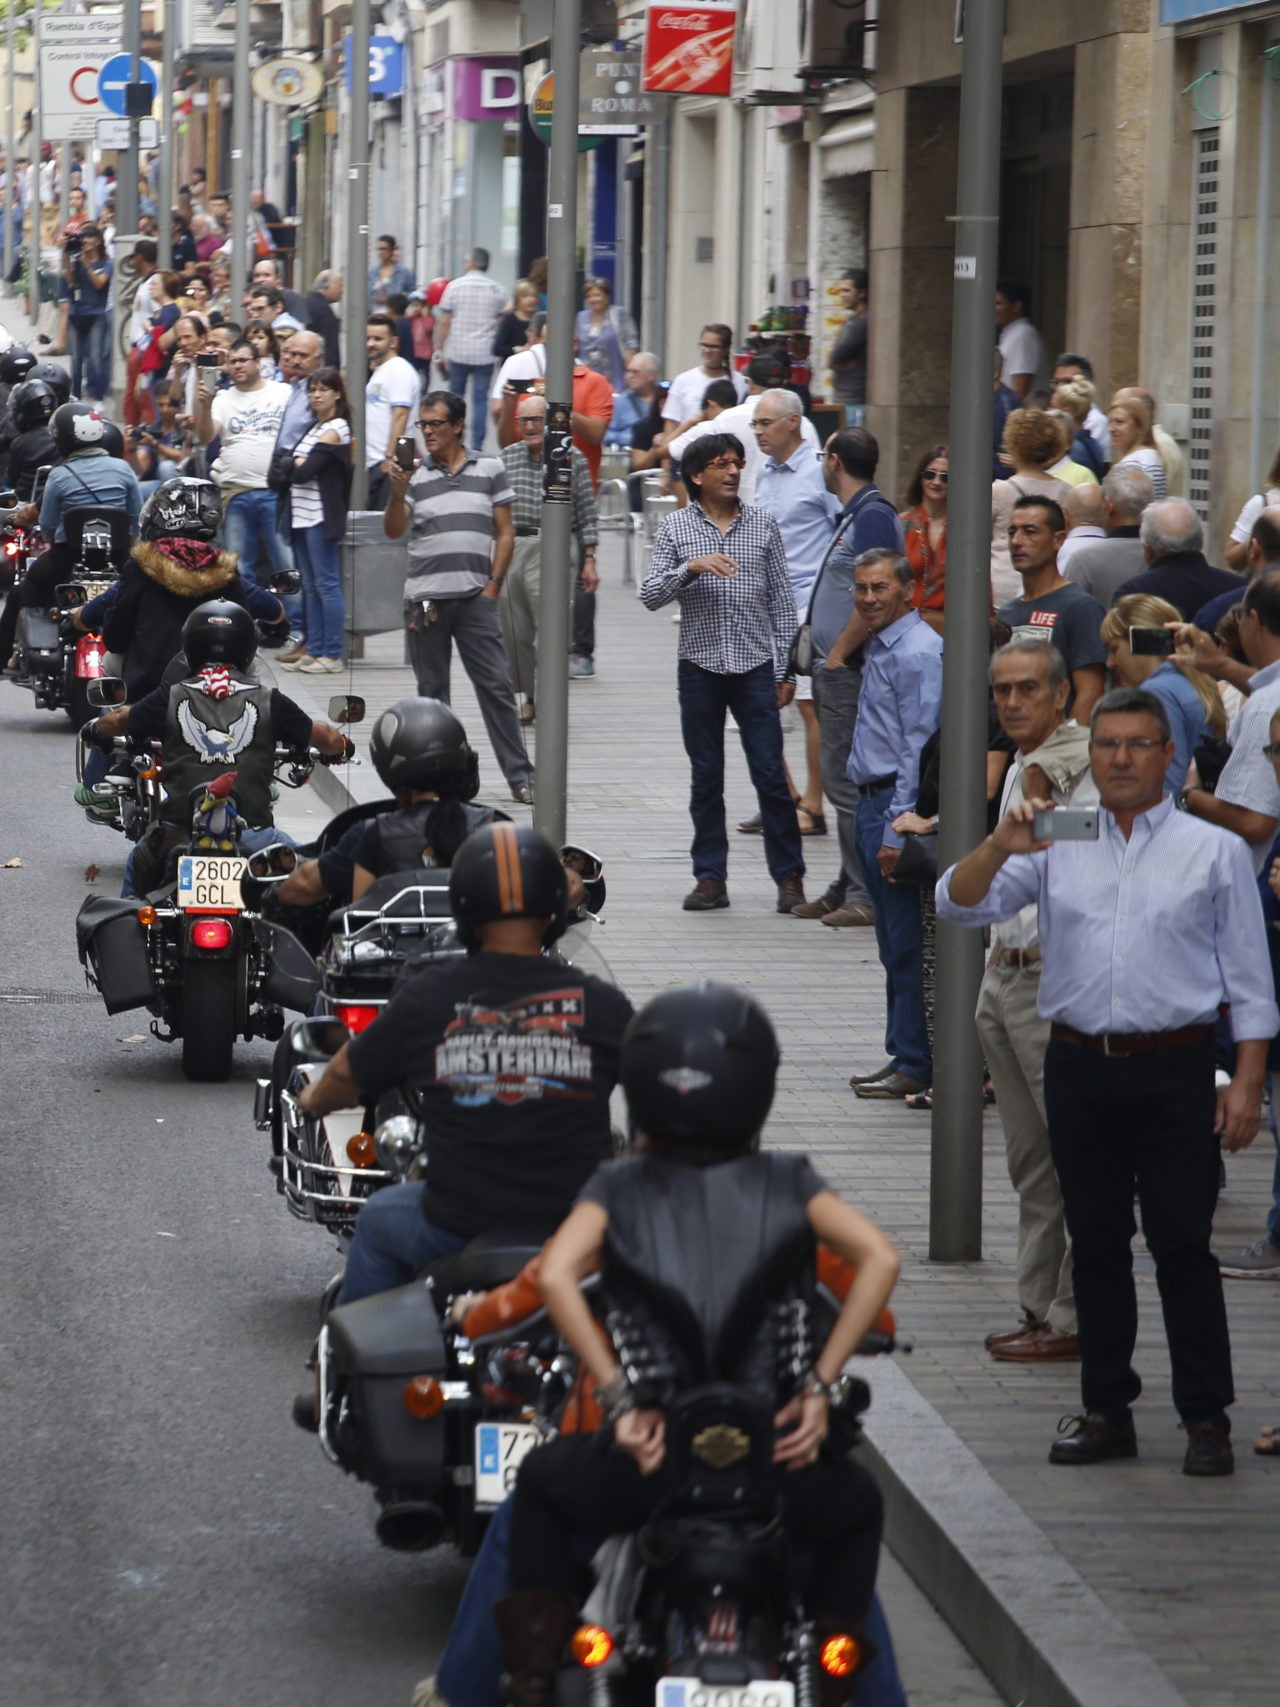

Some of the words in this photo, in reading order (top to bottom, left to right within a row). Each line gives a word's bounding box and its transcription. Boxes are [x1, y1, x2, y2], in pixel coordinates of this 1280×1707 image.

[45, 21, 85, 32] Rambla
[87, 20, 122, 33] d'Egar
[596, 62, 641, 77] PUN
[591, 97, 654, 113] ROMA
[1030, 611, 1058, 626] LIFE
[195, 860, 243, 881] 2602
[196, 884, 235, 905] GCL
[435, 1044, 593, 1081] AMSTERDAM
